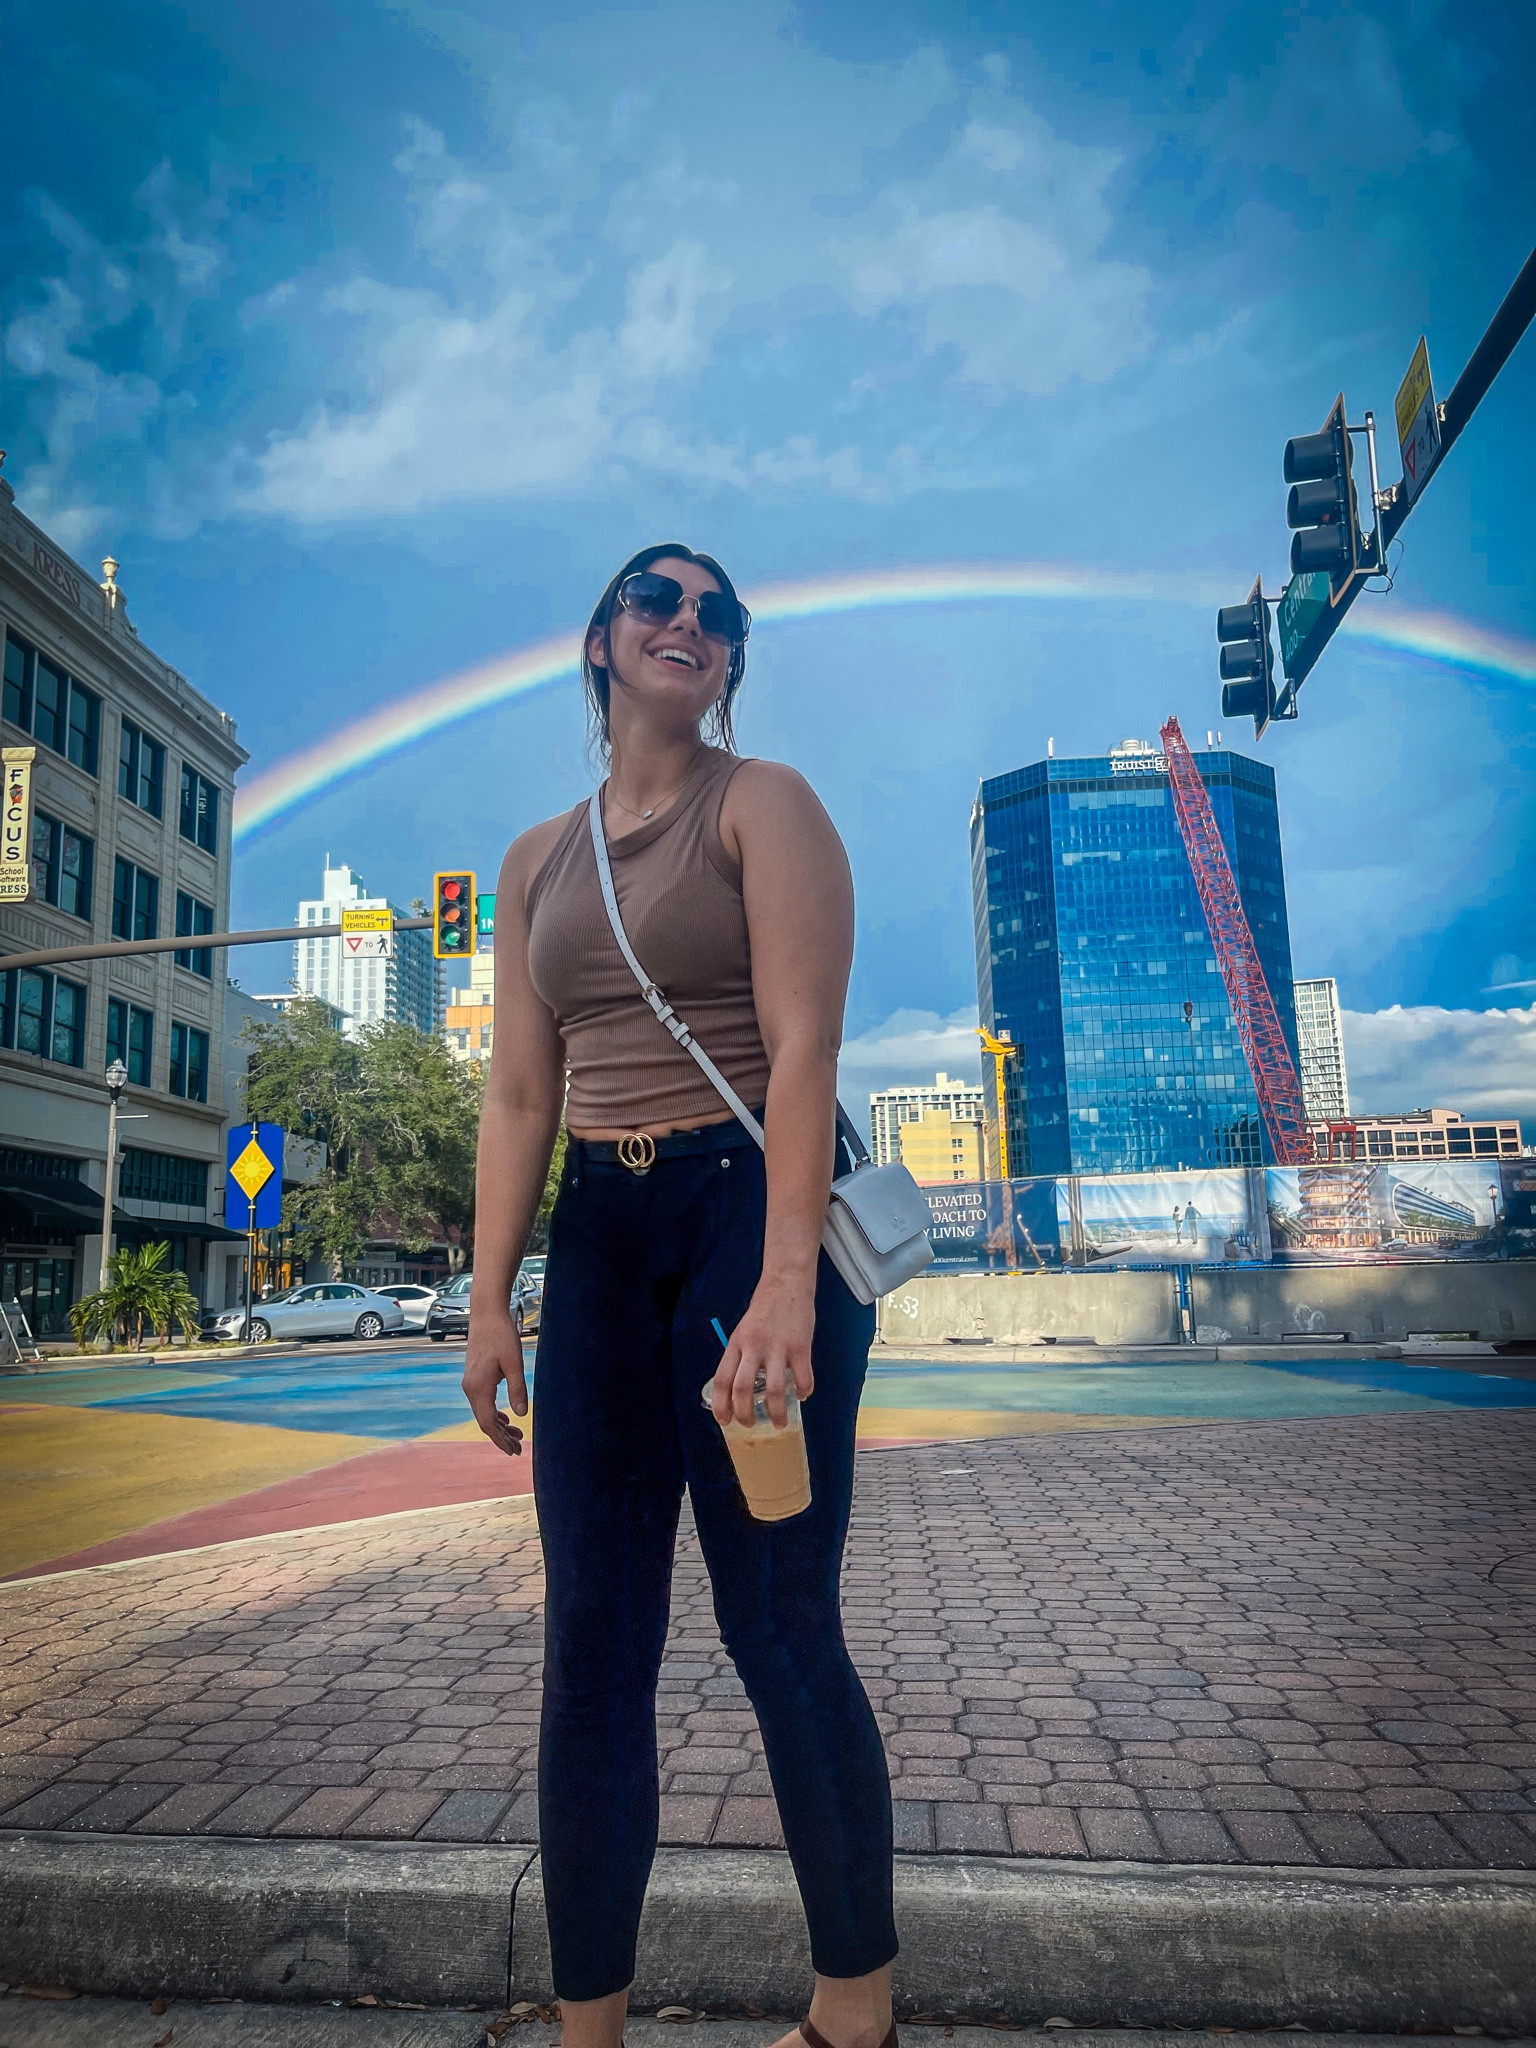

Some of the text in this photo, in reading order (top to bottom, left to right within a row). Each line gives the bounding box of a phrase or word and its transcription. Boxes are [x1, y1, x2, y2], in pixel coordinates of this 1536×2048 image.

[33, 542, 80, 606] KRESS
[1284, 572, 1316, 627] Centra
[1285, 629, 1298, 661] 400
[0, 866, 24, 875] School
[0, 875, 26, 883] oftware
[925, 1193, 982, 1209] LEVATED
[968, 1208, 987, 1221] TO
[932, 1225, 975, 1239] LIVING
